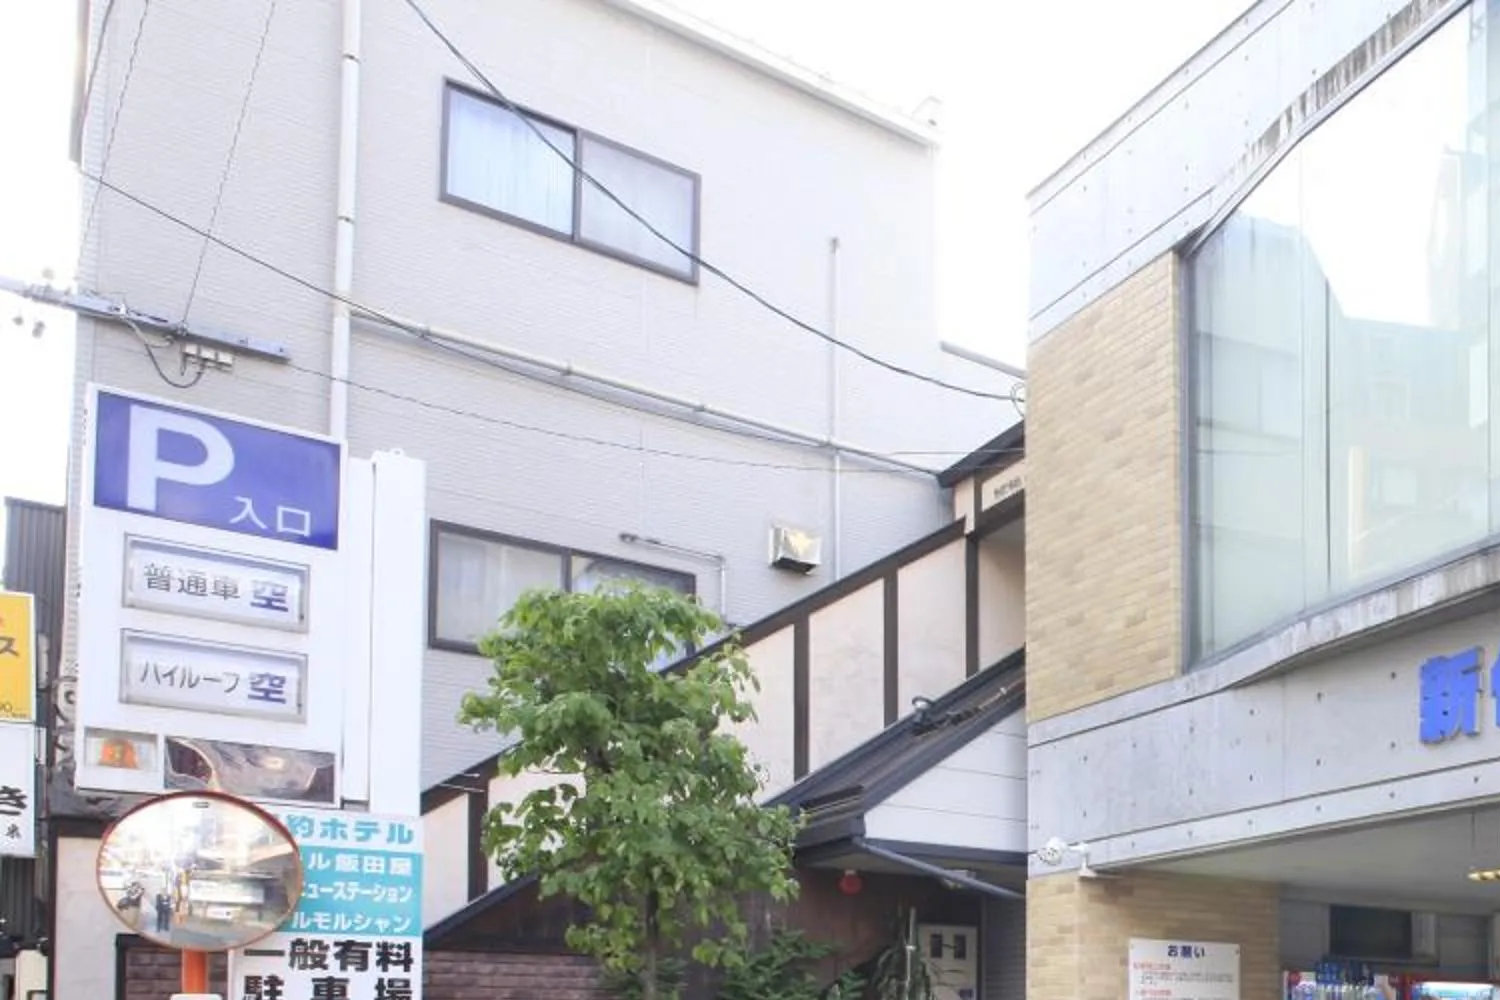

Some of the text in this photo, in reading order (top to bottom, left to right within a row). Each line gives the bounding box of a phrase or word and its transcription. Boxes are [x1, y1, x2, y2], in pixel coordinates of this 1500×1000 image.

[126, 403, 235, 512] P
[230, 496, 311, 537] 入口
[143, 563, 289, 613] 普通車 空
[140, 661, 287, 704] ハイルーフ 空
[300, 851, 413, 877] ル飯田屋
[301, 880, 414, 904] ューステーション
[243, 938, 414, 973] 一般有料
